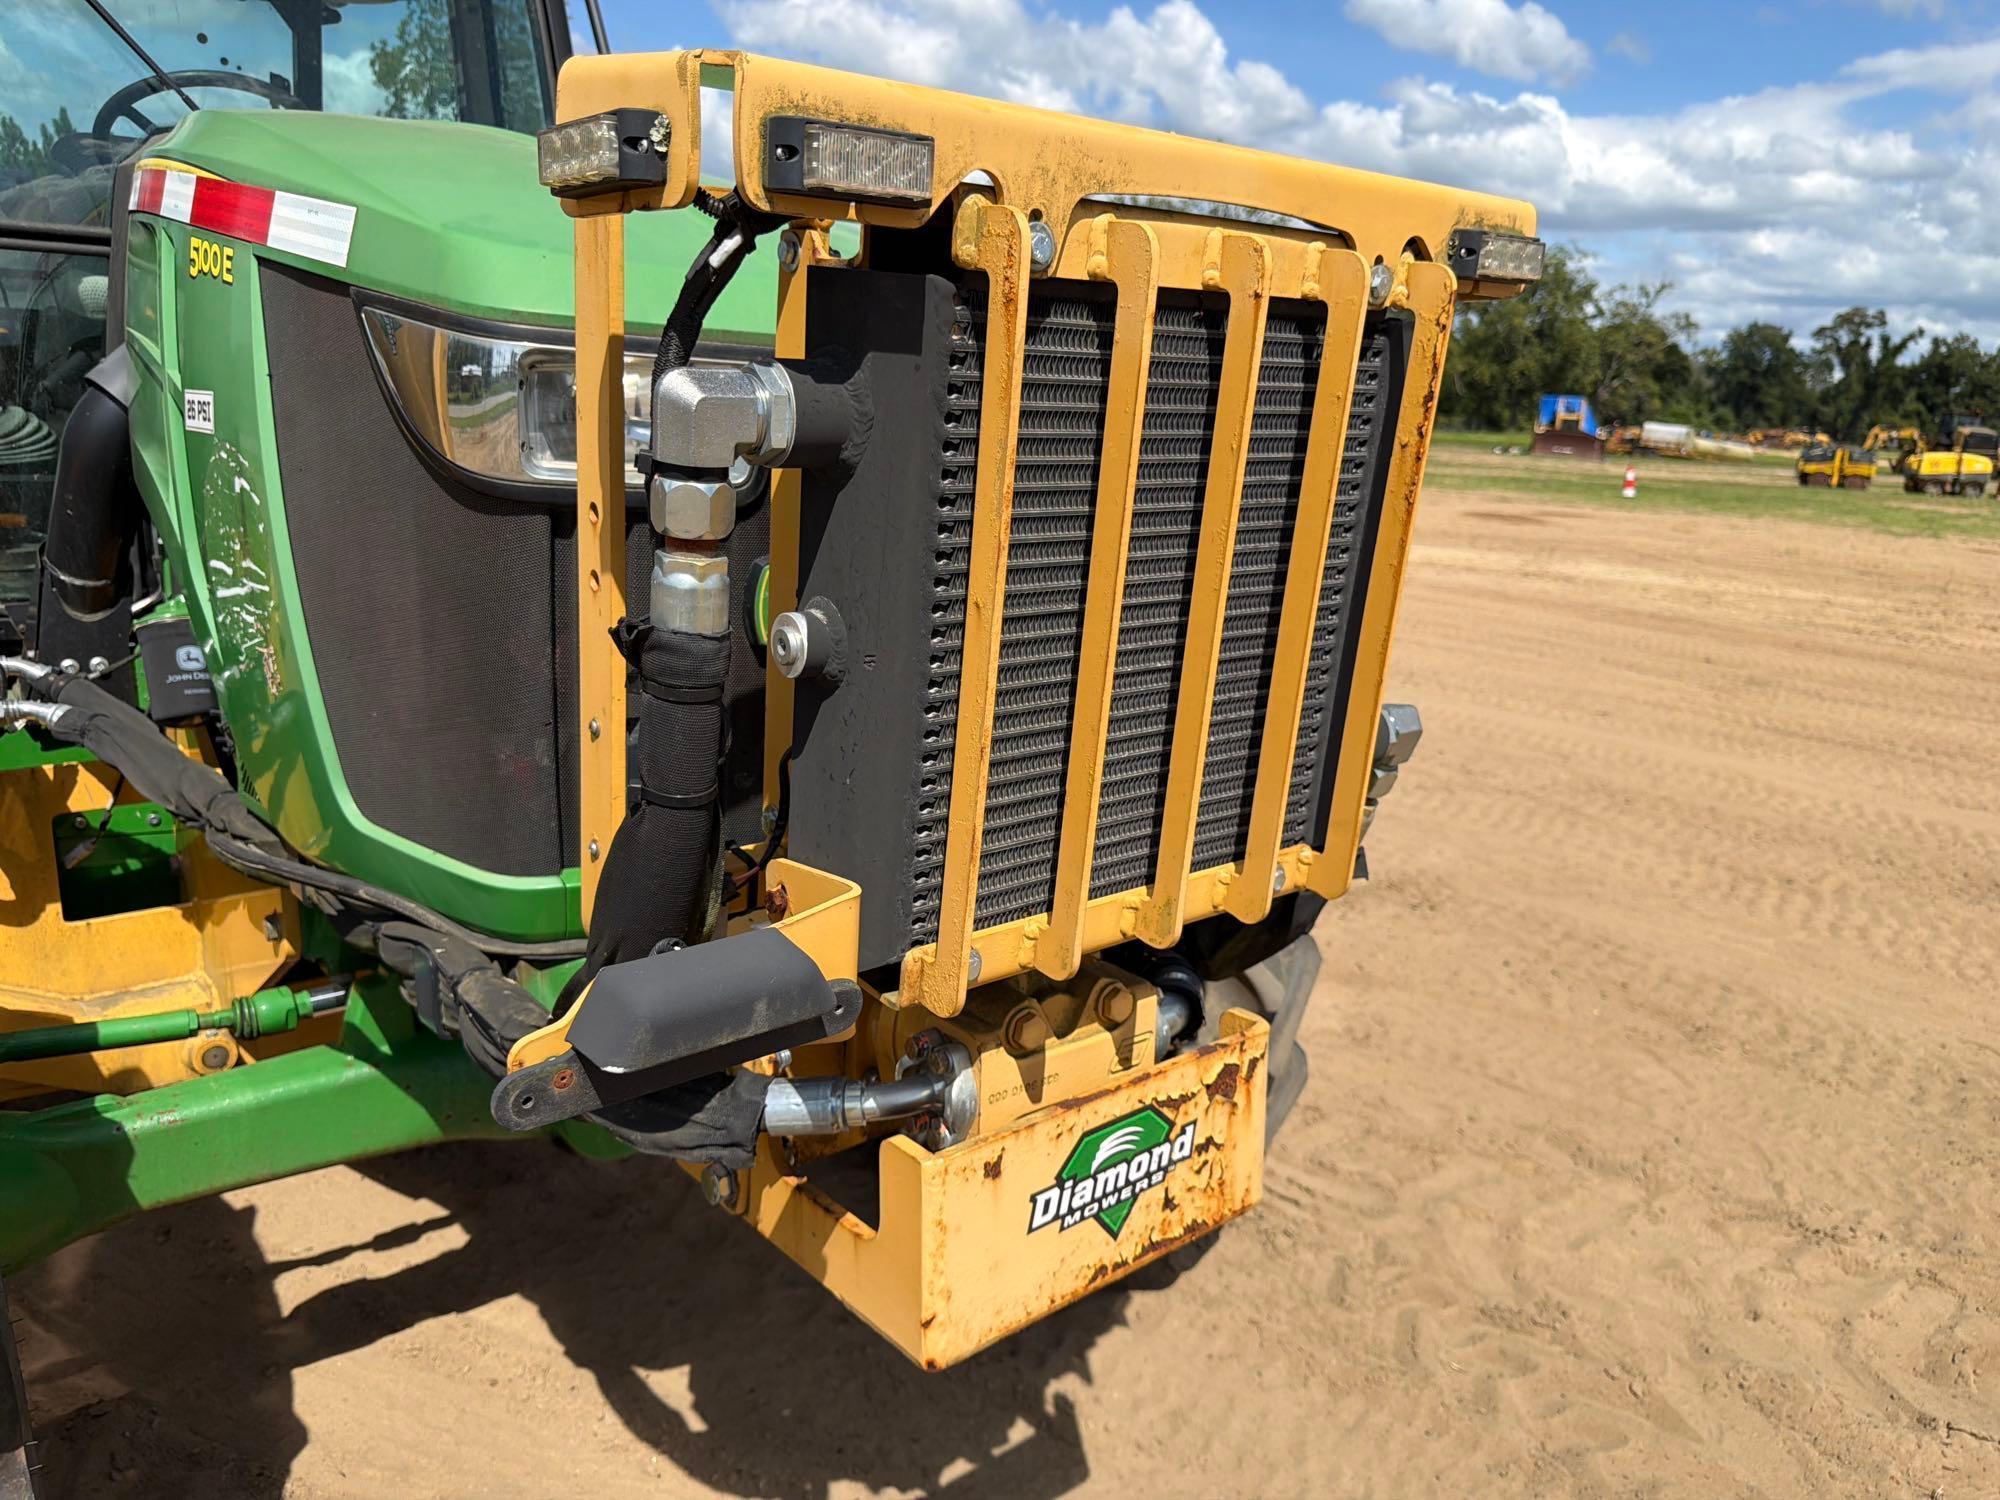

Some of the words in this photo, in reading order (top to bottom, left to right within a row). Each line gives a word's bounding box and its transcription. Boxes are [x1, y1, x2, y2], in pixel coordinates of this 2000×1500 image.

[197, 400, 212, 423] PSI
[166, 673, 192, 683] JOHN
[1031, 1122, 1196, 1230] Diamond
[1062, 1170, 1166, 1230] MOWERS
